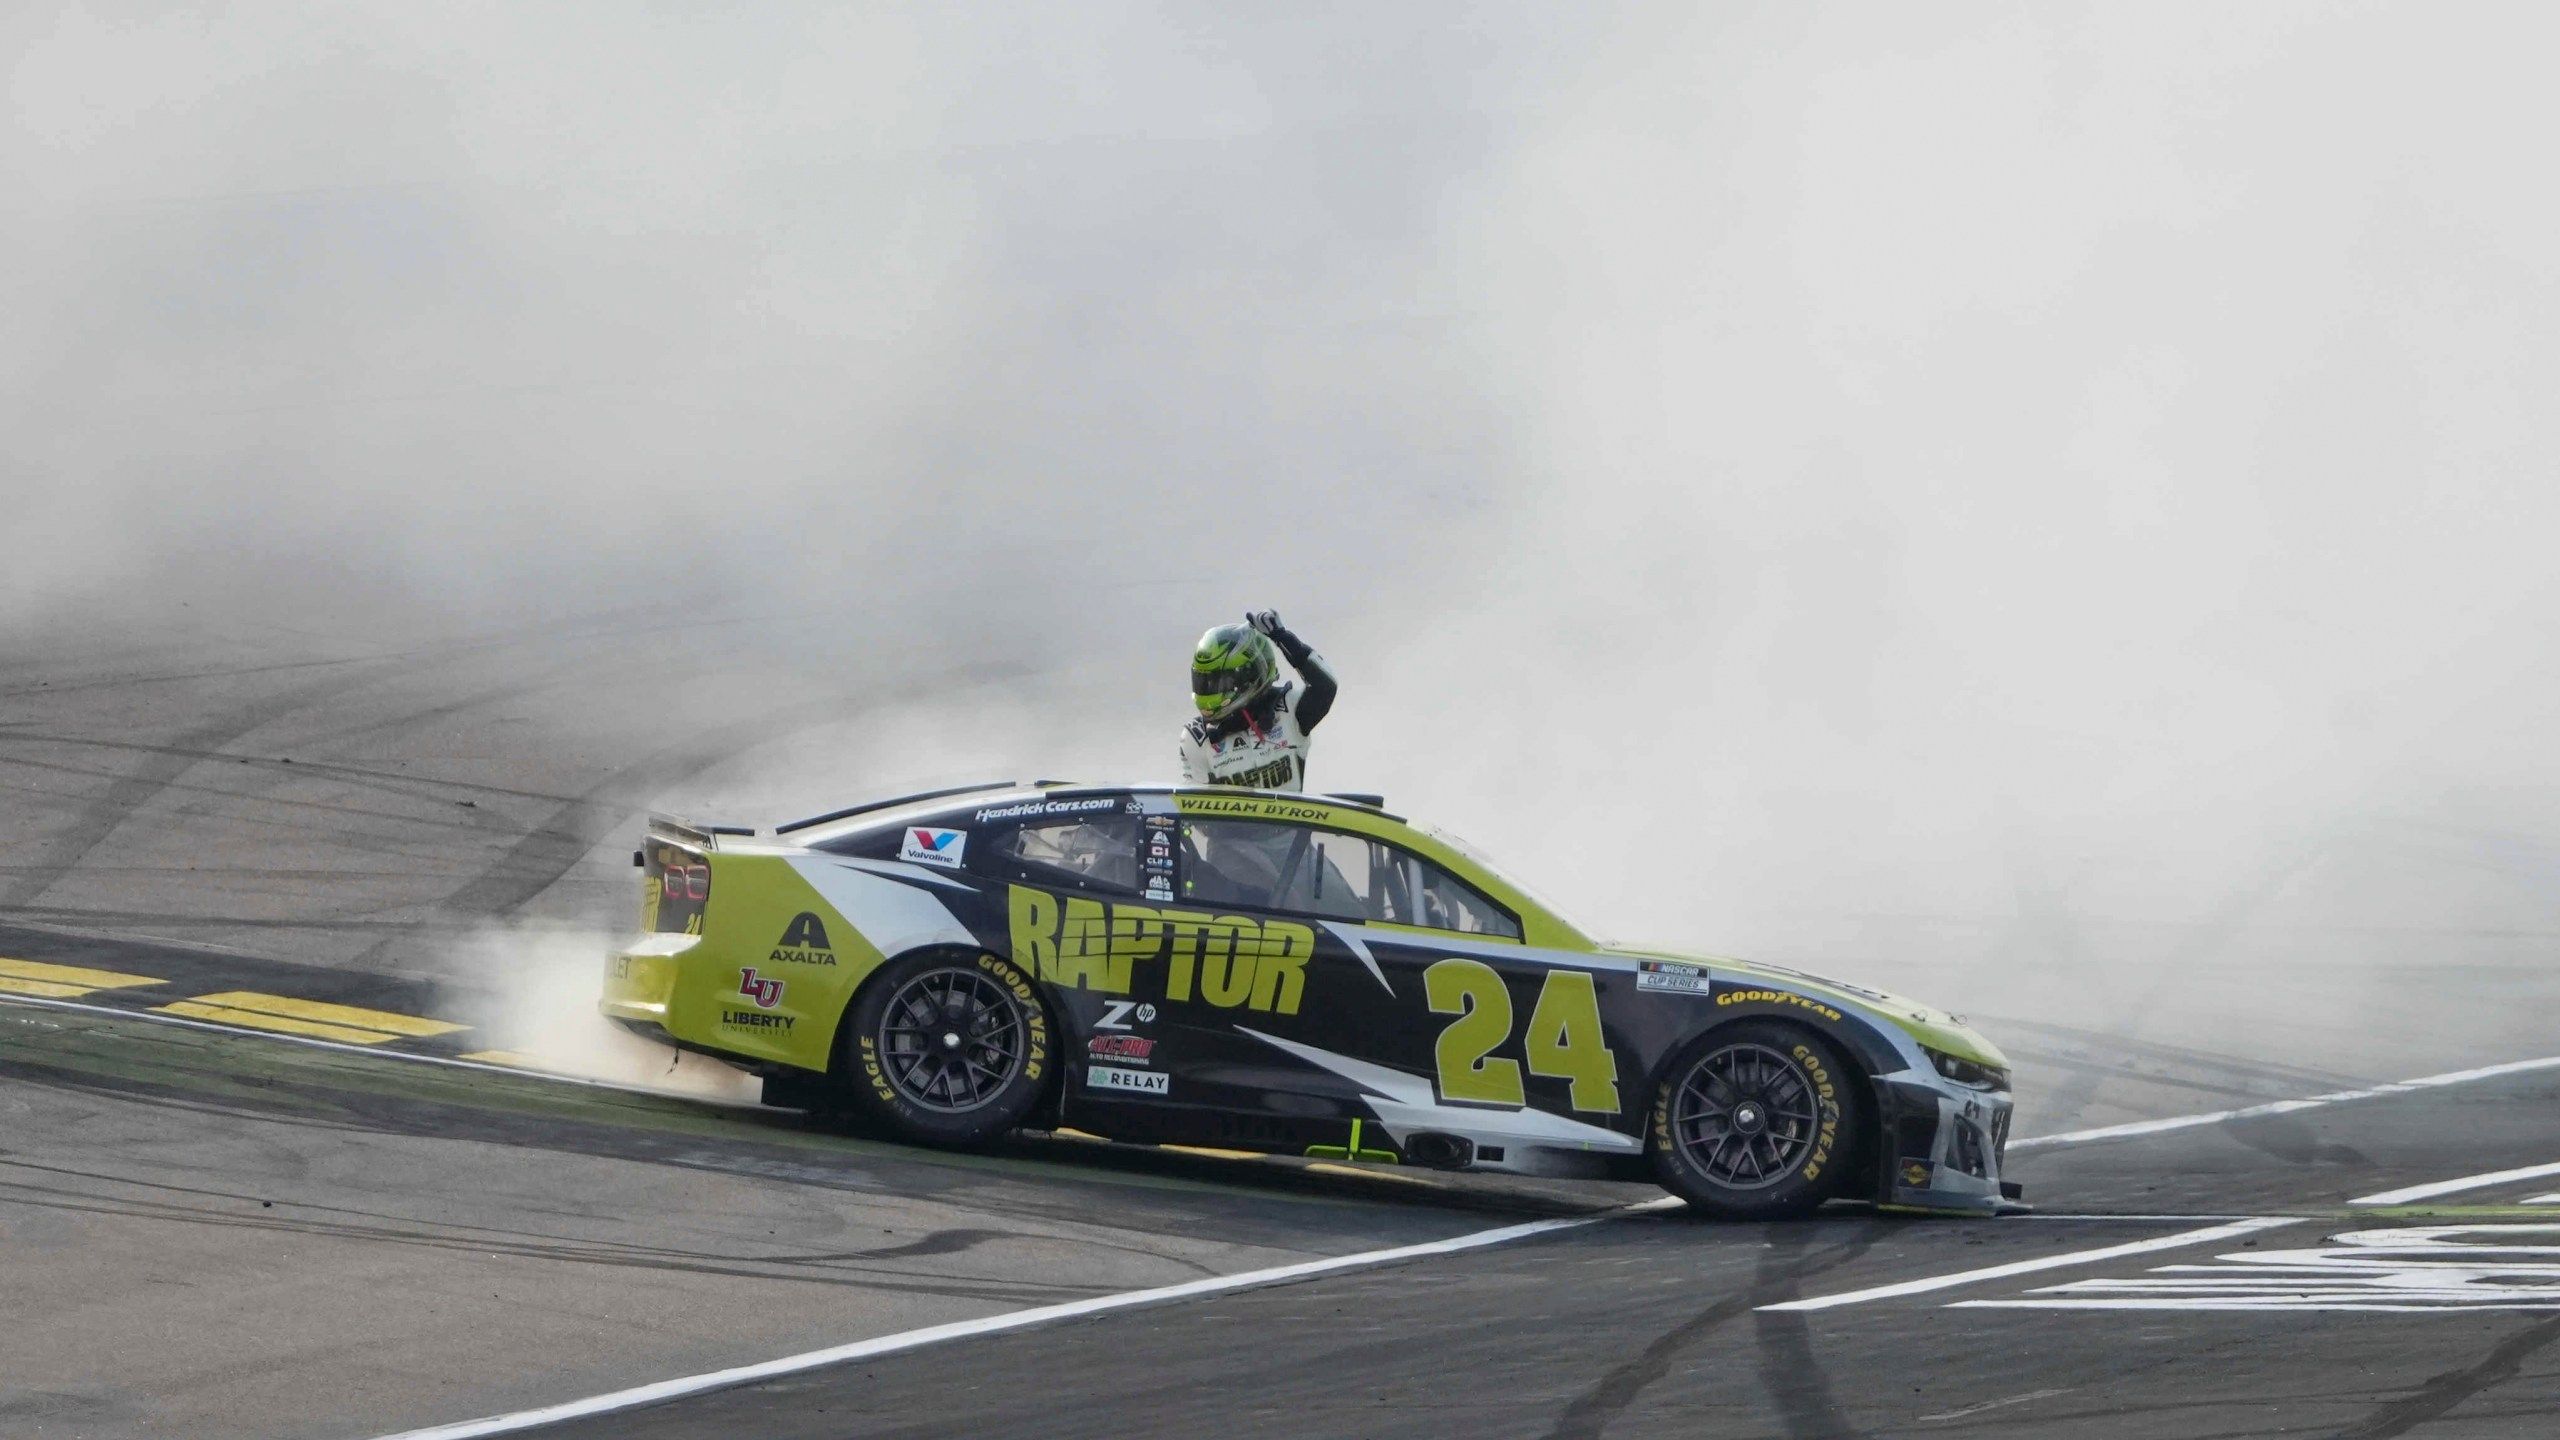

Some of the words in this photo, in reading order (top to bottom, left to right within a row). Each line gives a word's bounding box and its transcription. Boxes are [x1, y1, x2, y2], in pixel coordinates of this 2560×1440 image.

[1181, 800, 1257, 813] WILLIAM
[1264, 804, 1331, 820] BYRON
[908, 849, 954, 864] Valvoline
[769, 949, 837, 966] AXALTA
[1008, 884, 1315, 1015] RAPTOR
[1647, 975, 1666, 985] CUP
[1667, 977, 1700, 988] SERIES
[1661, 964, 1699, 976] NASCAR
[739, 967, 784, 1008] LU
[978, 954, 1046, 1080] GOODYEAR
[1138, 1003, 1155, 1021] hp
[1716, 990, 1842, 1021] GOODYEAR
[723, 1011, 796, 1030] LIBERTY
[1423, 958, 1622, 1113] 24
[860, 1035, 896, 1100] EAGLE
[1111, 1073, 1165, 1089] RELAY
[1654, 1082, 1674, 1151] EAGLE
[1793, 1045, 1840, 1181] GOODYEAR
